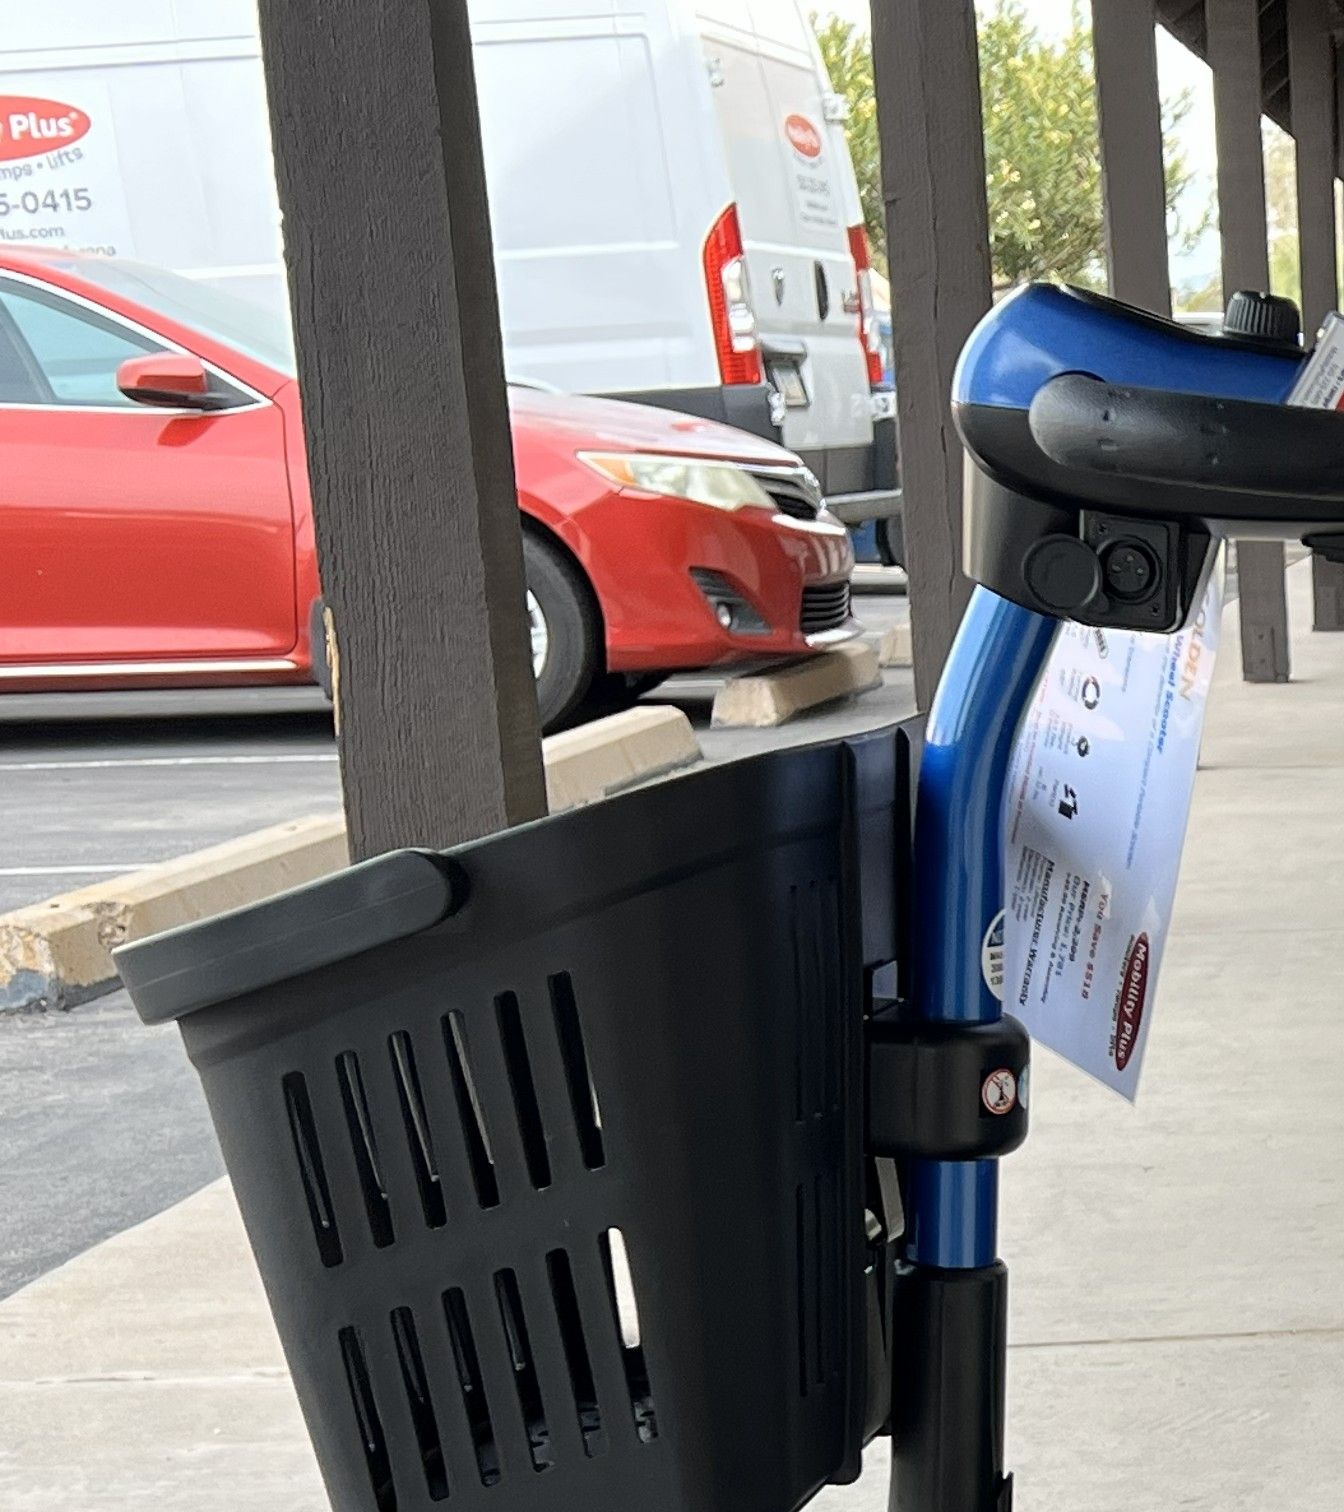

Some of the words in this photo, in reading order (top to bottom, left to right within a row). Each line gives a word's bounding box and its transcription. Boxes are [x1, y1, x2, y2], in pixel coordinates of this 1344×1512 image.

[8, 111, 74, 141] Plus
[1168, 634, 1184, 687] Wheel
[1180, 594, 1209, 701] OLDEN
[1156, 690, 1175, 754] Scooter
[1096, 894, 1109, 920] You
[1088, 923, 1103, 960] Save
[1019, 947, 1038, 1007] Warranty
[1123, 942, 1148, 1020] Mobility
[1118, 1021, 1134, 1059] Plus
